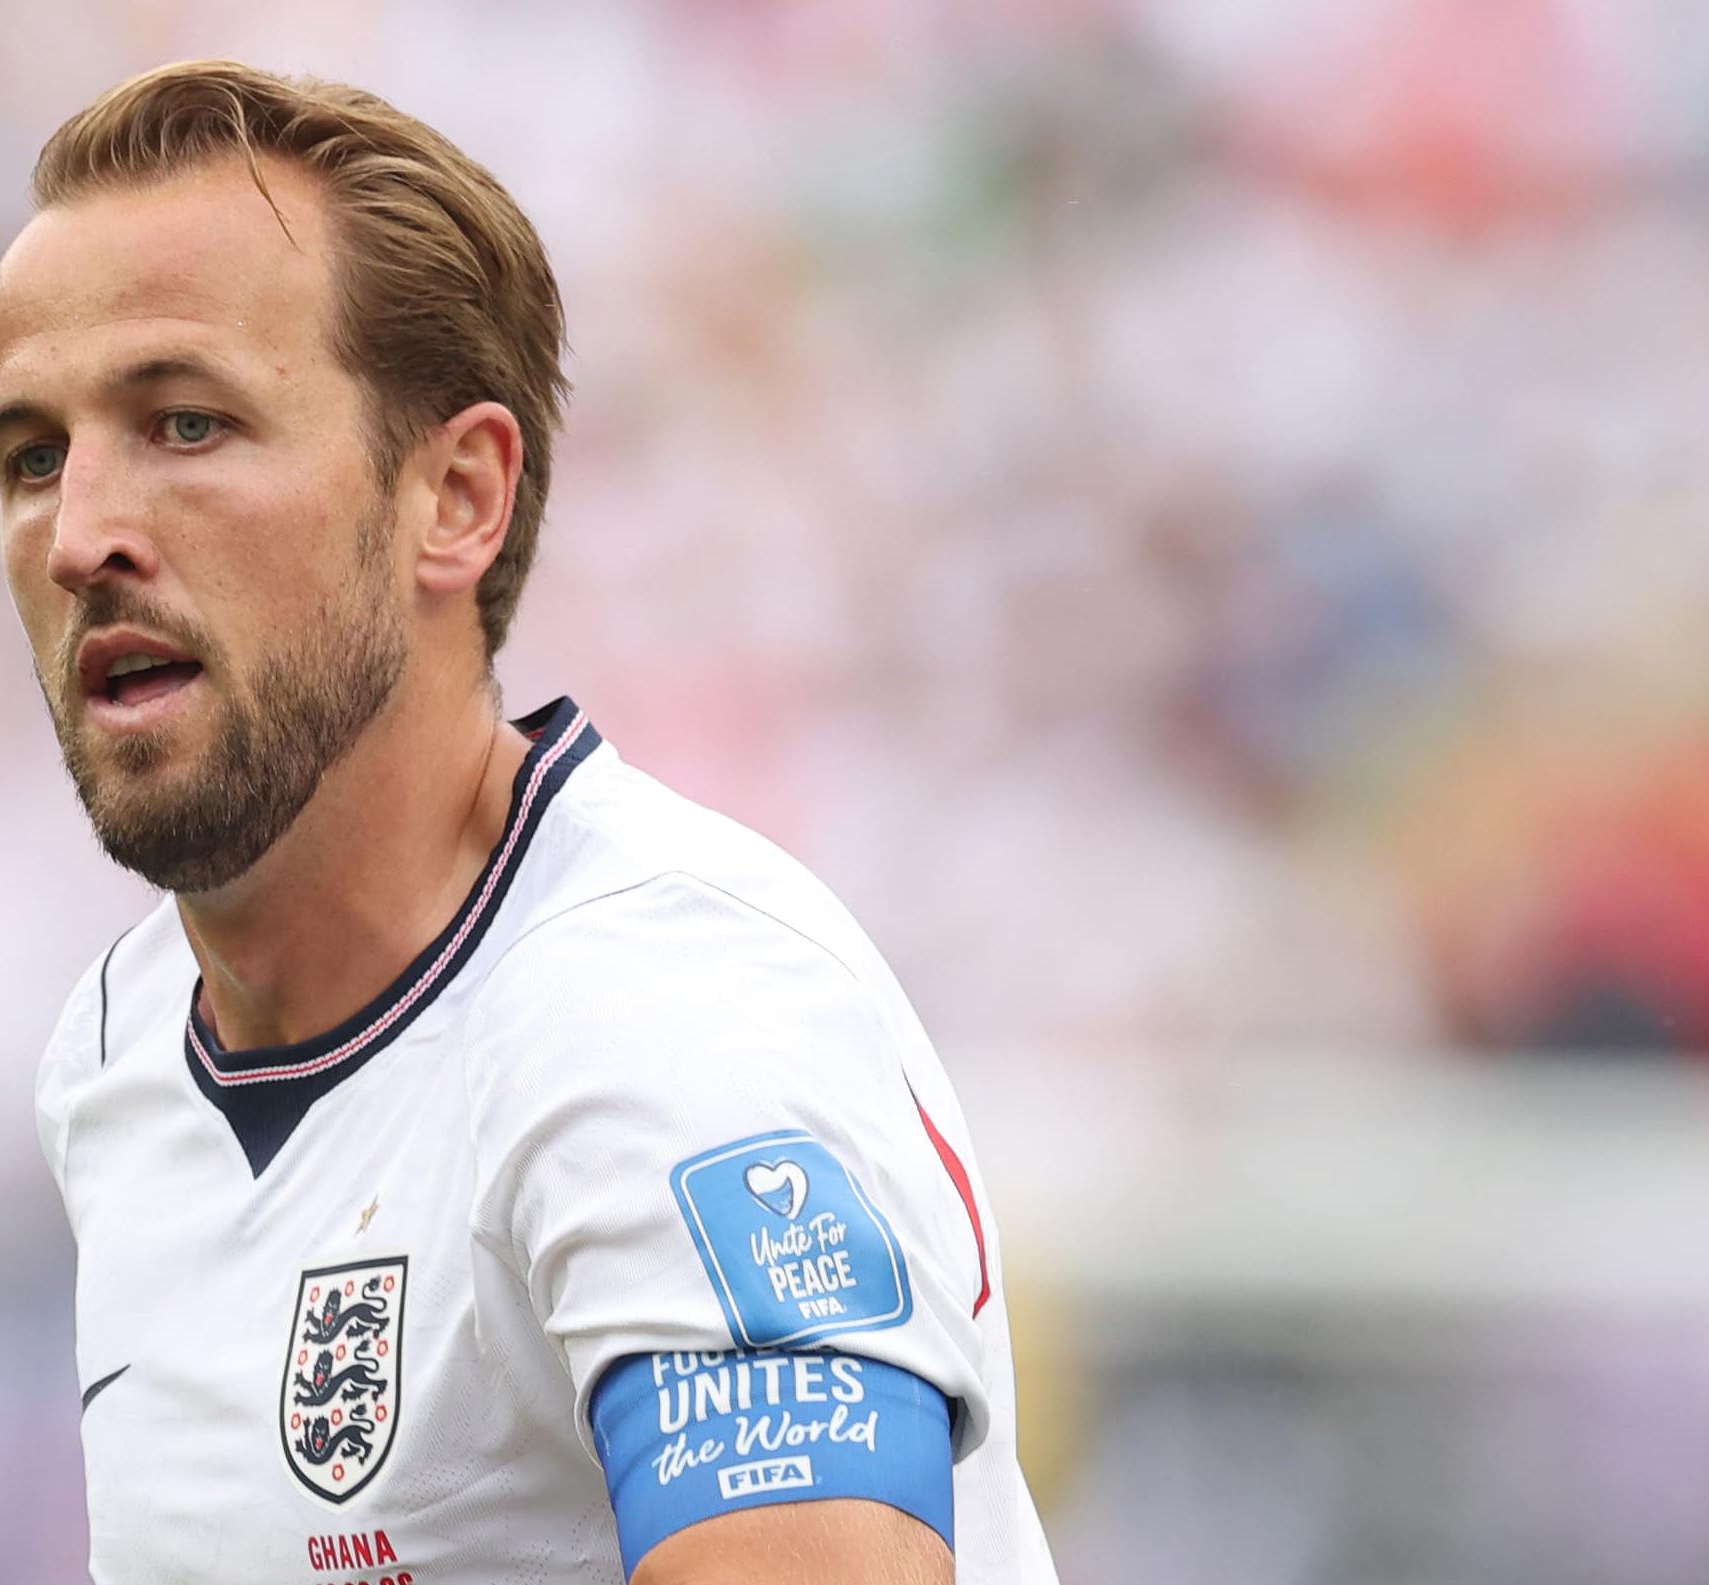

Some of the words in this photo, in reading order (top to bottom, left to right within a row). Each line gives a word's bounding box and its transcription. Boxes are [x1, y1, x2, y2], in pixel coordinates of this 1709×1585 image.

[750, 1223, 813, 1268] Unite
[809, 1212, 847, 1253] For
[767, 1250, 857, 1302] PEACE
[798, 1296, 845, 1320] FIFA
[658, 1356, 865, 1434] UNITES
[652, 1433, 725, 1486] the
[735, 1404, 879, 1456] World
[727, 1463, 806, 1491] FIFA
[308, 1529, 398, 1571] GHANA
